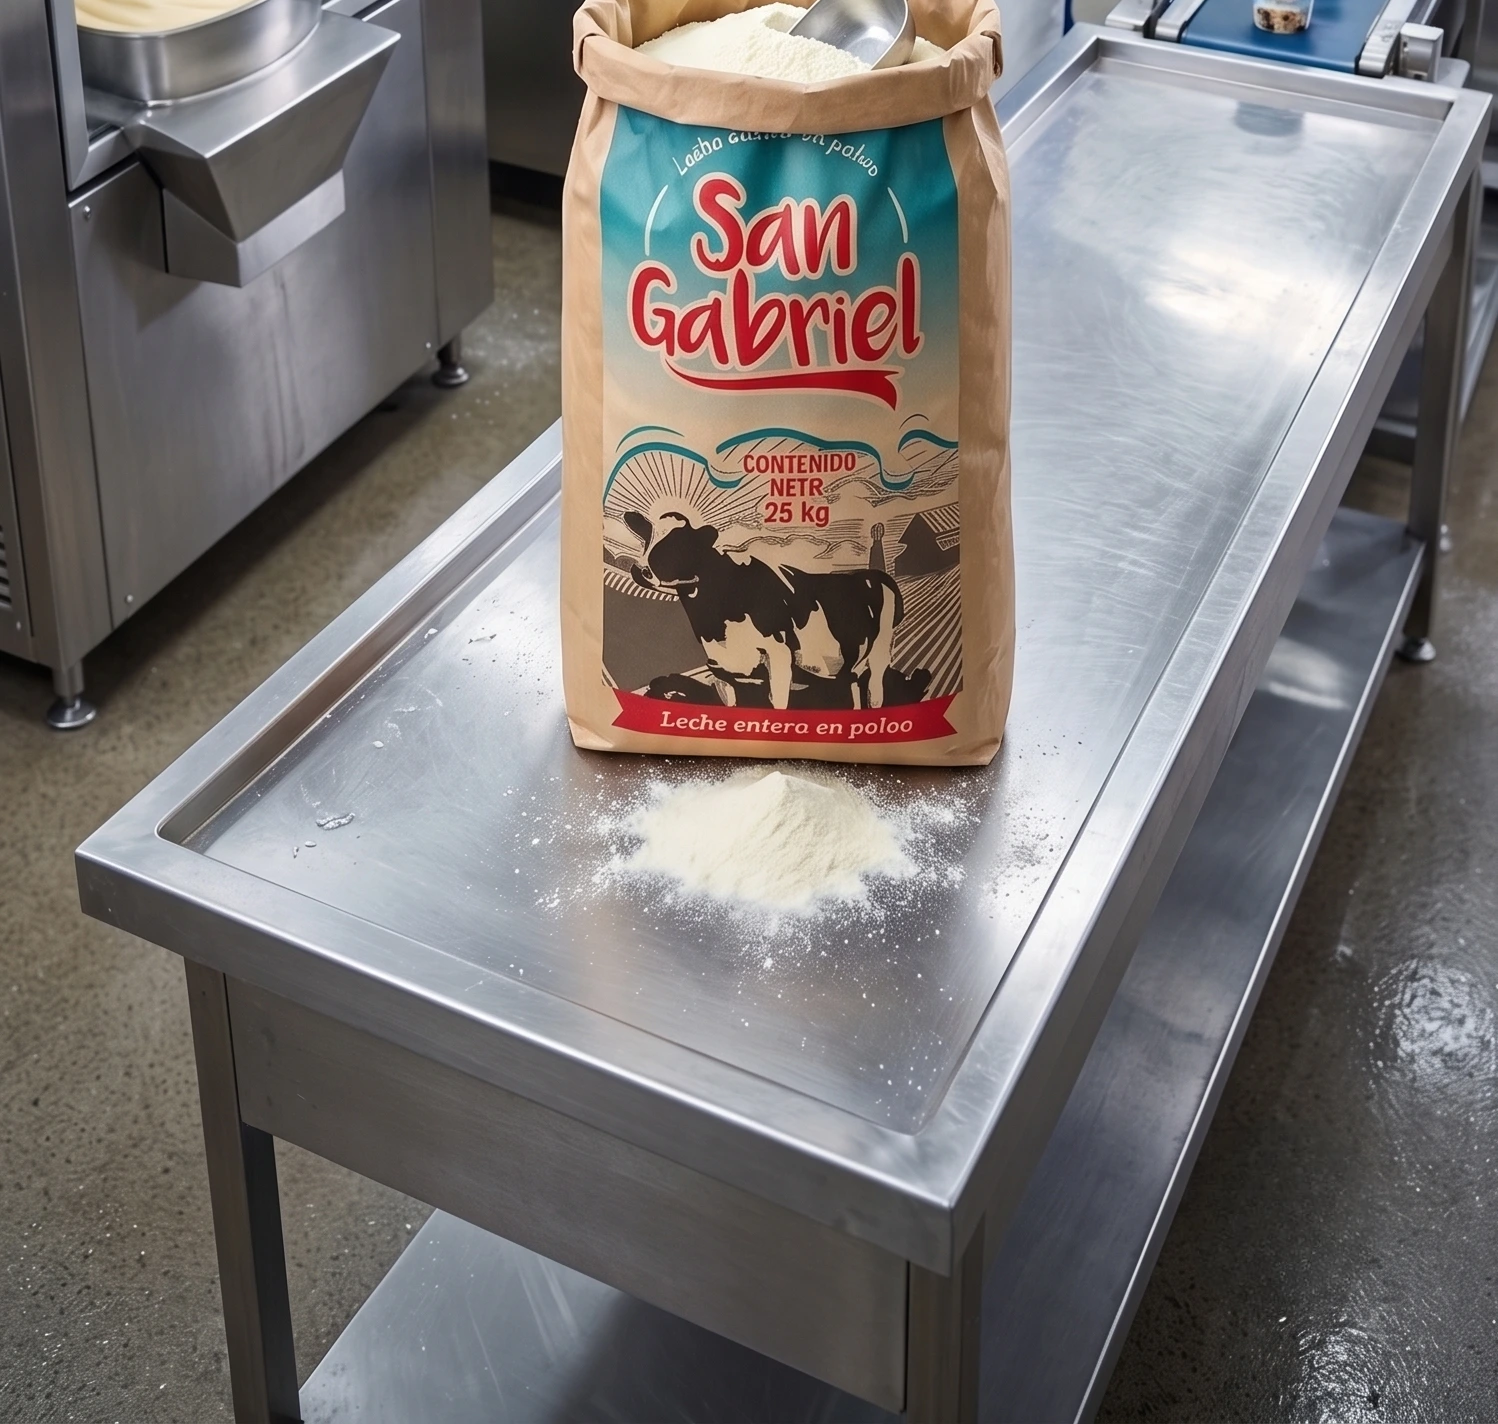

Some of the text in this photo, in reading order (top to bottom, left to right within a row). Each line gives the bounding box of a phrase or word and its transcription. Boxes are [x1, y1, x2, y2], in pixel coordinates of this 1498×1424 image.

[694, 177, 854, 277] San
[630, 256, 922, 368] Gabriel
[743, 452, 857, 474] CONTENIDO
[770, 477, 824, 497] NETR
[764, 501, 830, 528] 25 kg
[660, 710, 728, 732] Leche
[733, 718, 809, 735] entera
[816, 720, 843, 735] en
